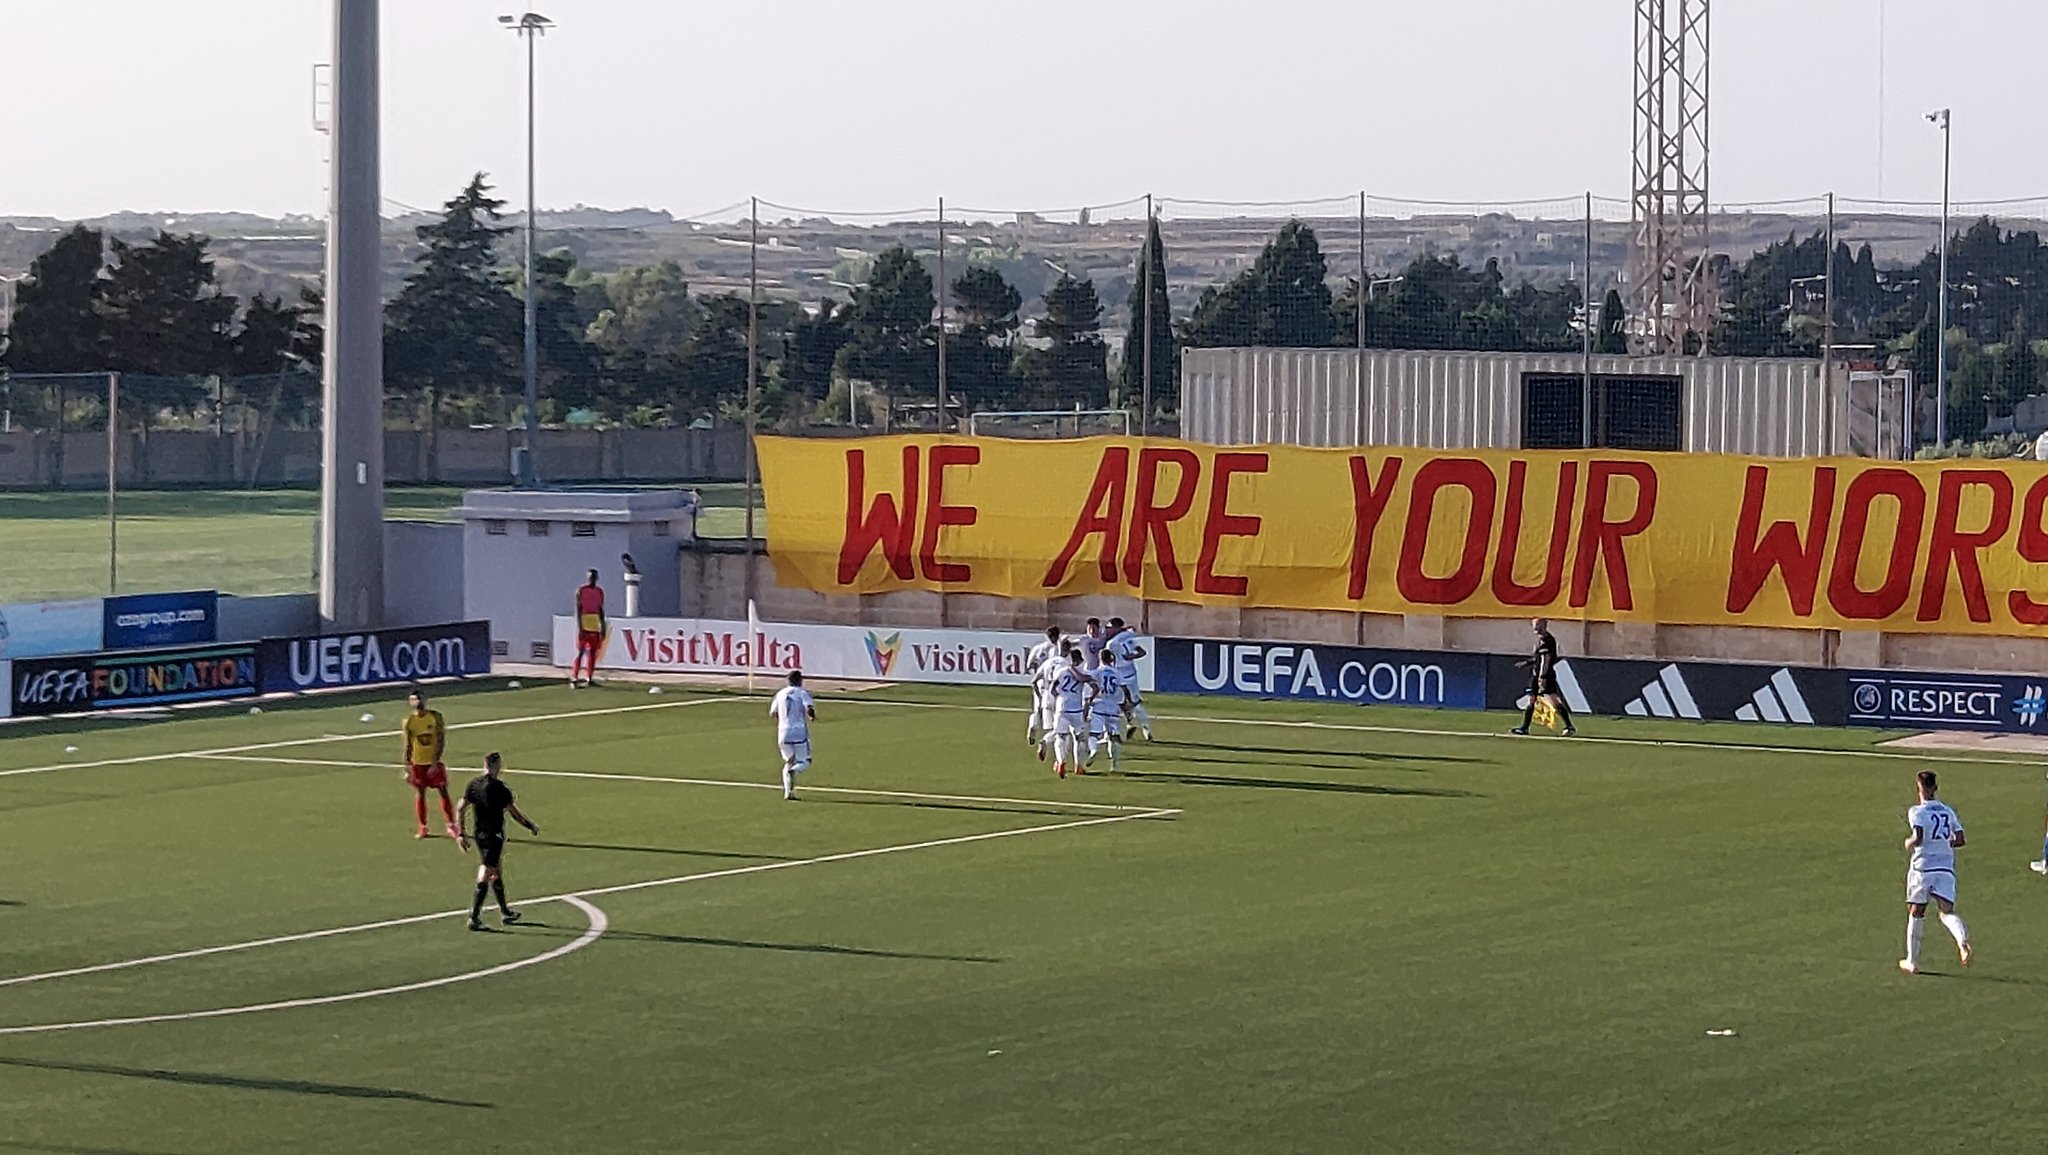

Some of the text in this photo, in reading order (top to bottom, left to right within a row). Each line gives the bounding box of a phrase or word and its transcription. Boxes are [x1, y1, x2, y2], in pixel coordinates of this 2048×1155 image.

[837, 445, 981, 585] WE
[1043, 447, 1269, 596] ARE
[1347, 456, 1658, 611] YOUR
[288, 634, 465, 686] UEFA.com
[620, 628, 801, 669] VisitMalta
[911, 644, 1032, 675] VisitMal
[20, 657, 256, 704] UEFA FOUNDATION
[1193, 643, 1444, 703] UEFA.com
[1891, 688, 2000, 717] RESPECT
[1930, 813, 1951, 840] 23
